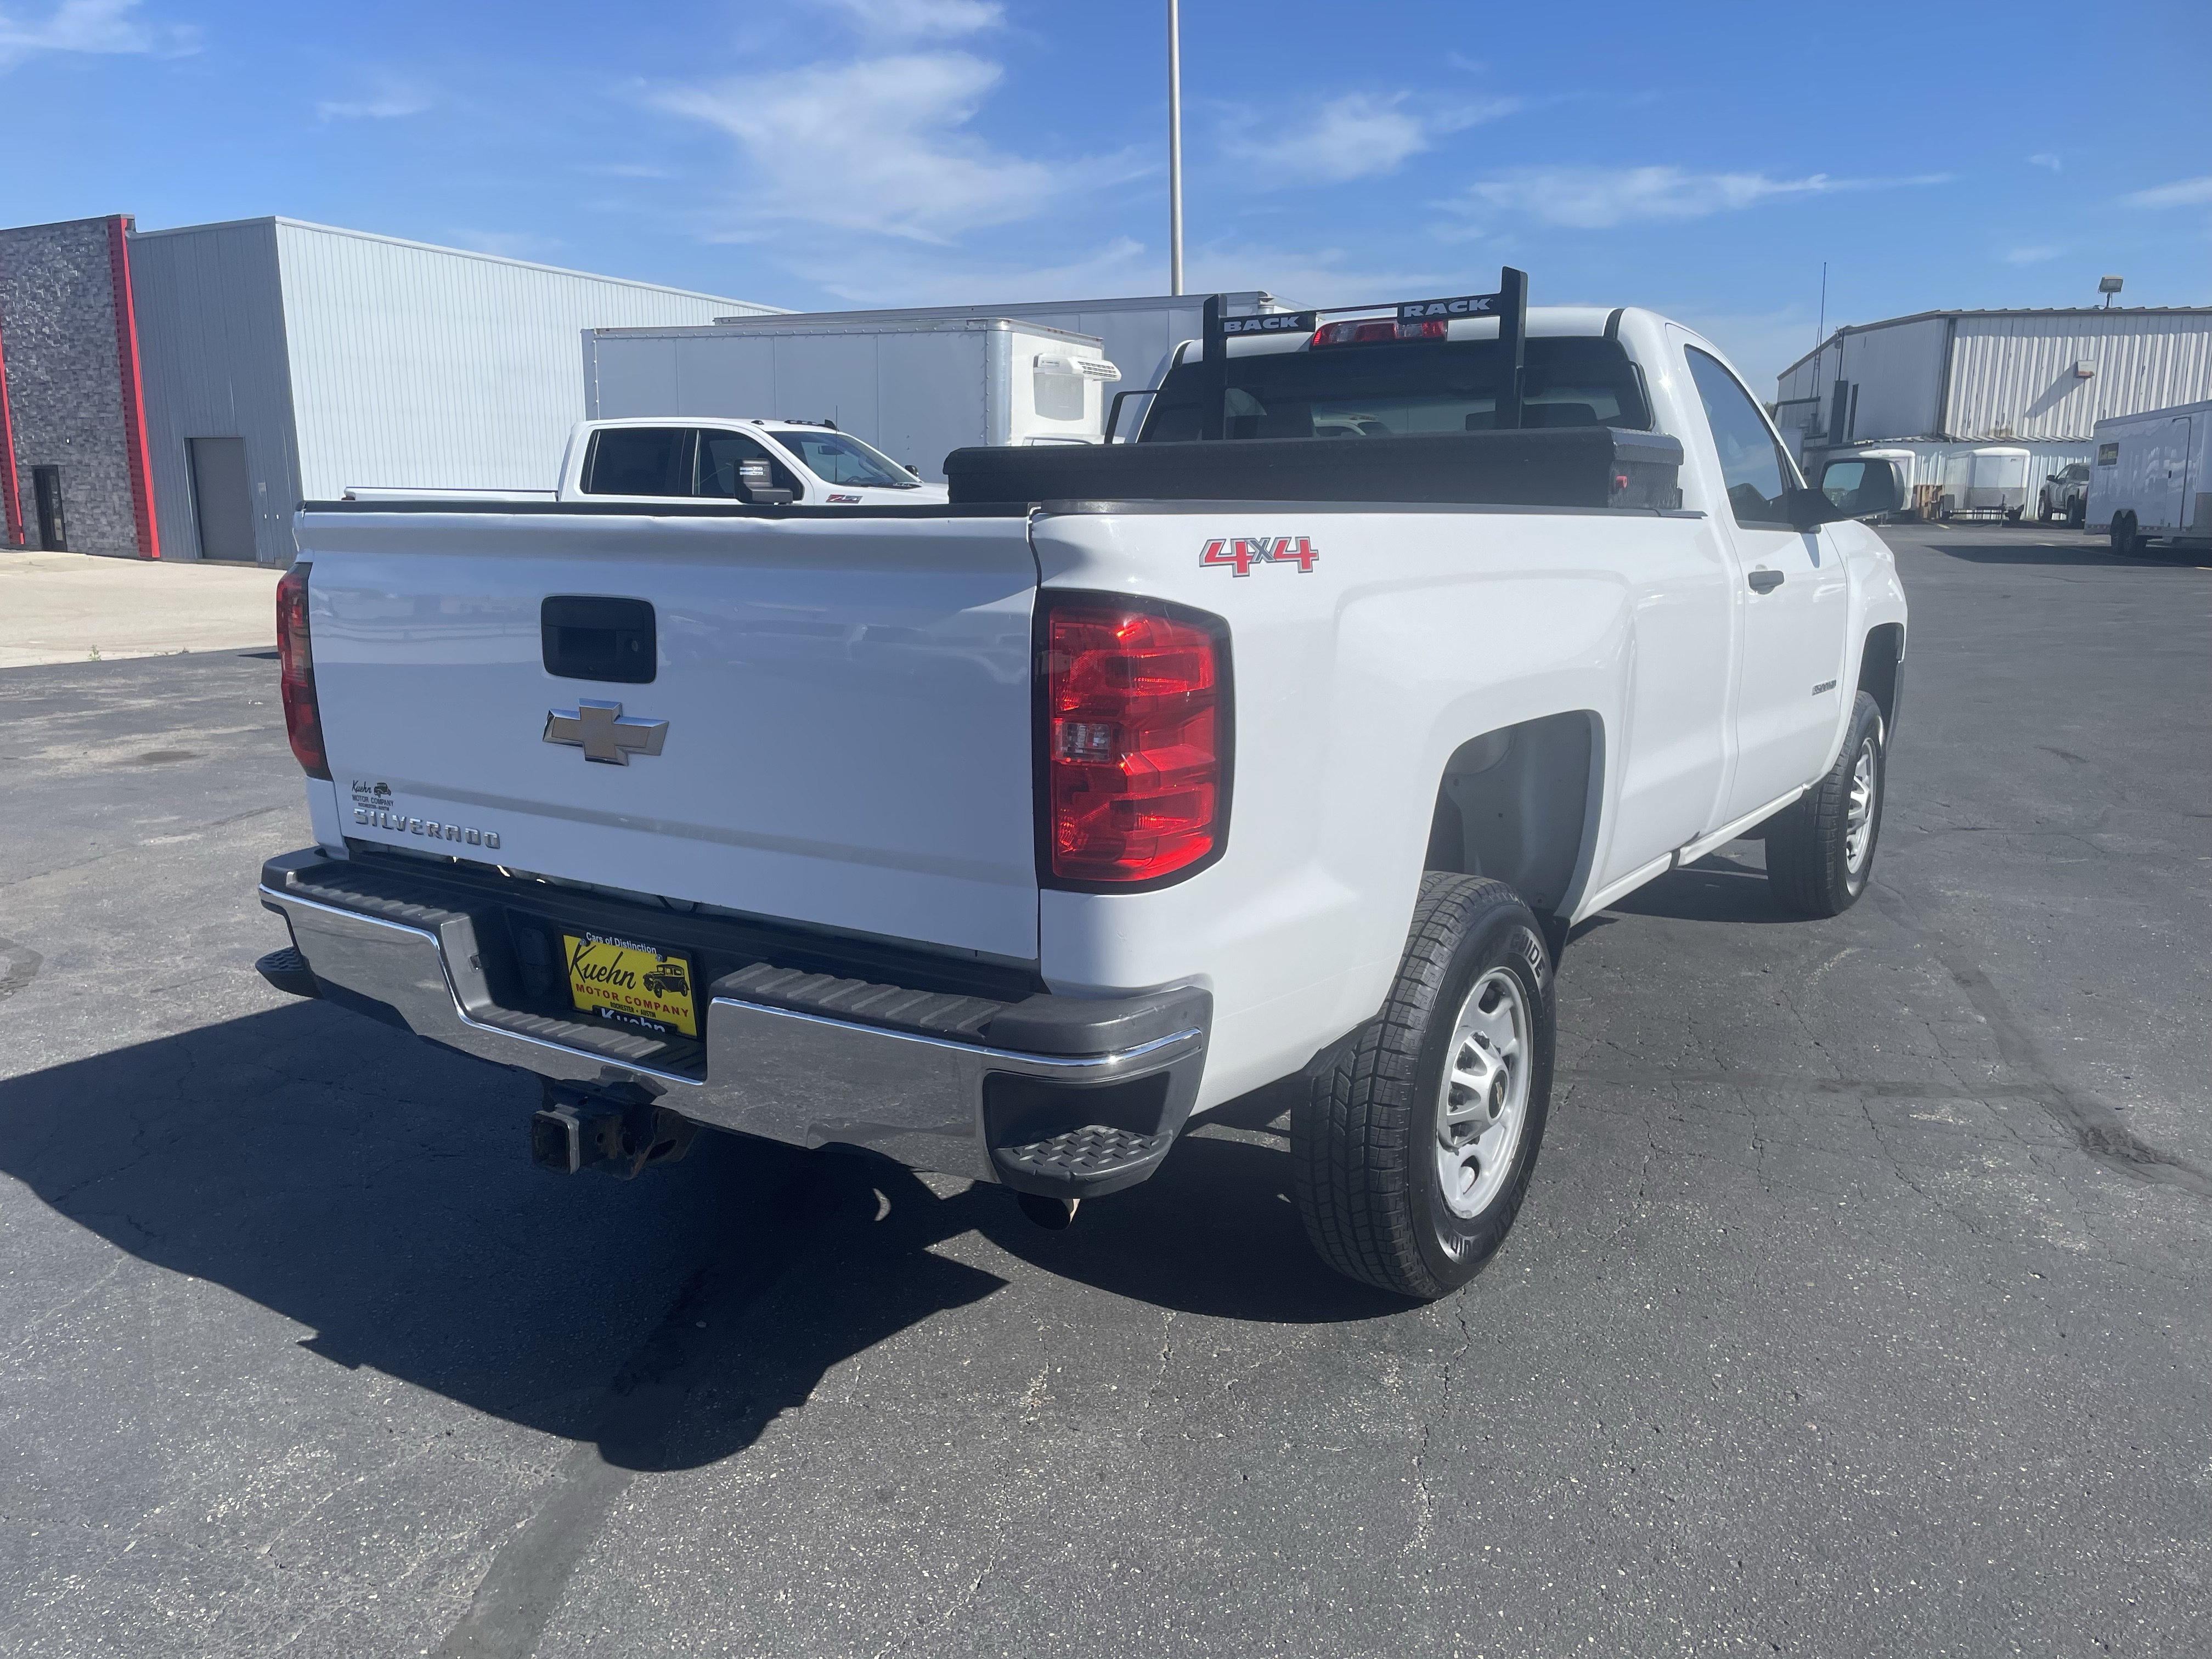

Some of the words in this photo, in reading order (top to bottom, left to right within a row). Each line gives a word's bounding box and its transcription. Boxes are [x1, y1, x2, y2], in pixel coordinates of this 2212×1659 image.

[1223, 316, 1299, 332] BACK
[1403, 297, 1492, 318] RACK
[352, 794, 369, 803] MOTOR
[370, 797, 393, 806] COMPANY
[354, 808, 501, 849] SILVERADO
[586, 932, 603, 944] Cars
[605, 936, 613, 945] of
[614, 938, 657, 955] Distinction
[569, 943, 636, 990] Kuehn
[575, 983, 620, 1001] MOTOR
[625, 995, 689, 1017] COMPANY
